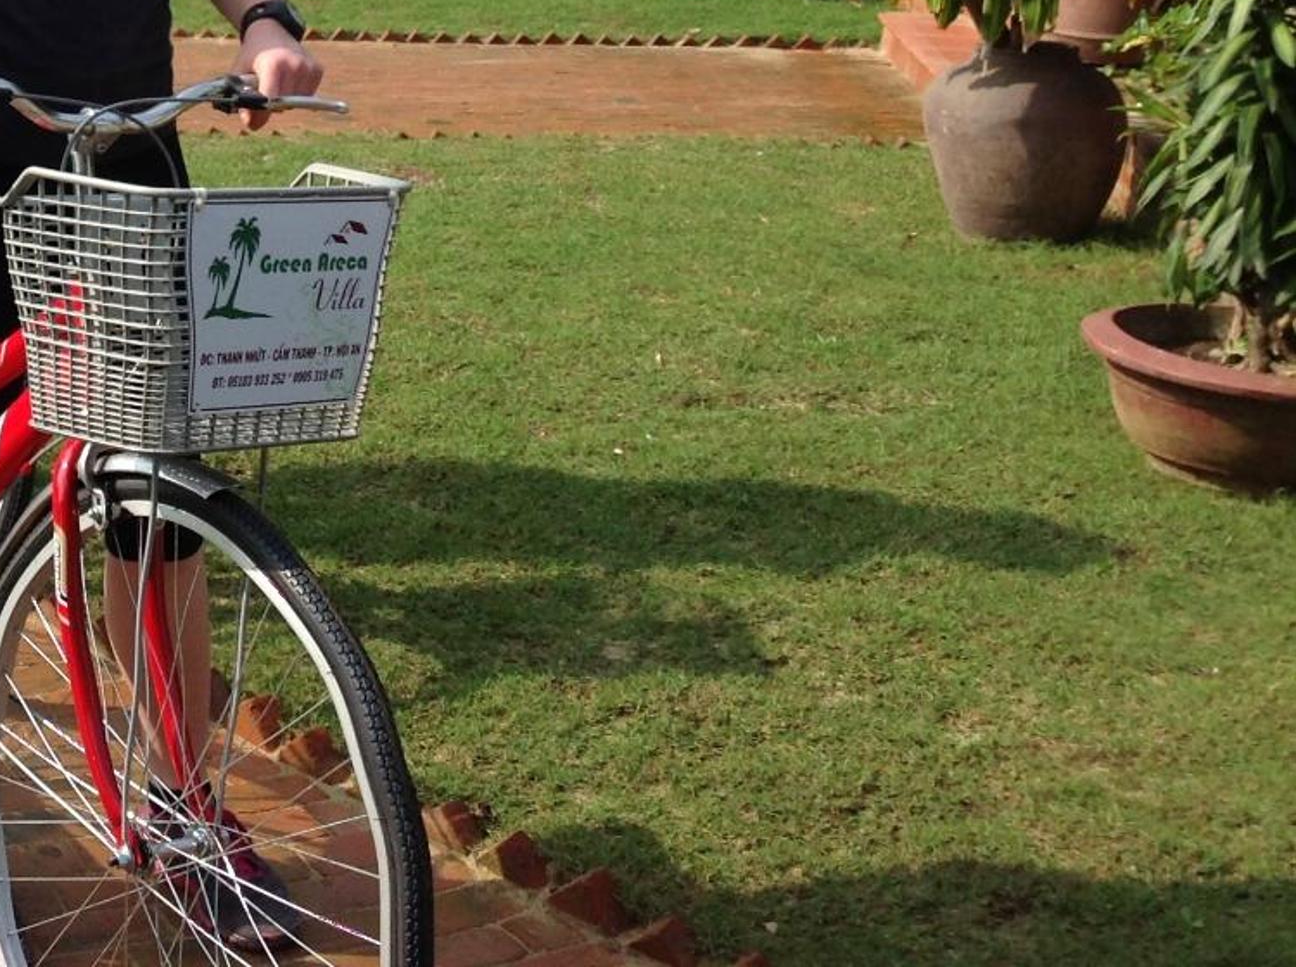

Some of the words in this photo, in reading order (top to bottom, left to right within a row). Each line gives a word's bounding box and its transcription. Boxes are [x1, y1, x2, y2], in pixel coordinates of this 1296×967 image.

[260, 254, 312, 274] Green
[317, 252, 368, 271] Areca
[312, 278, 365, 311] Villa
